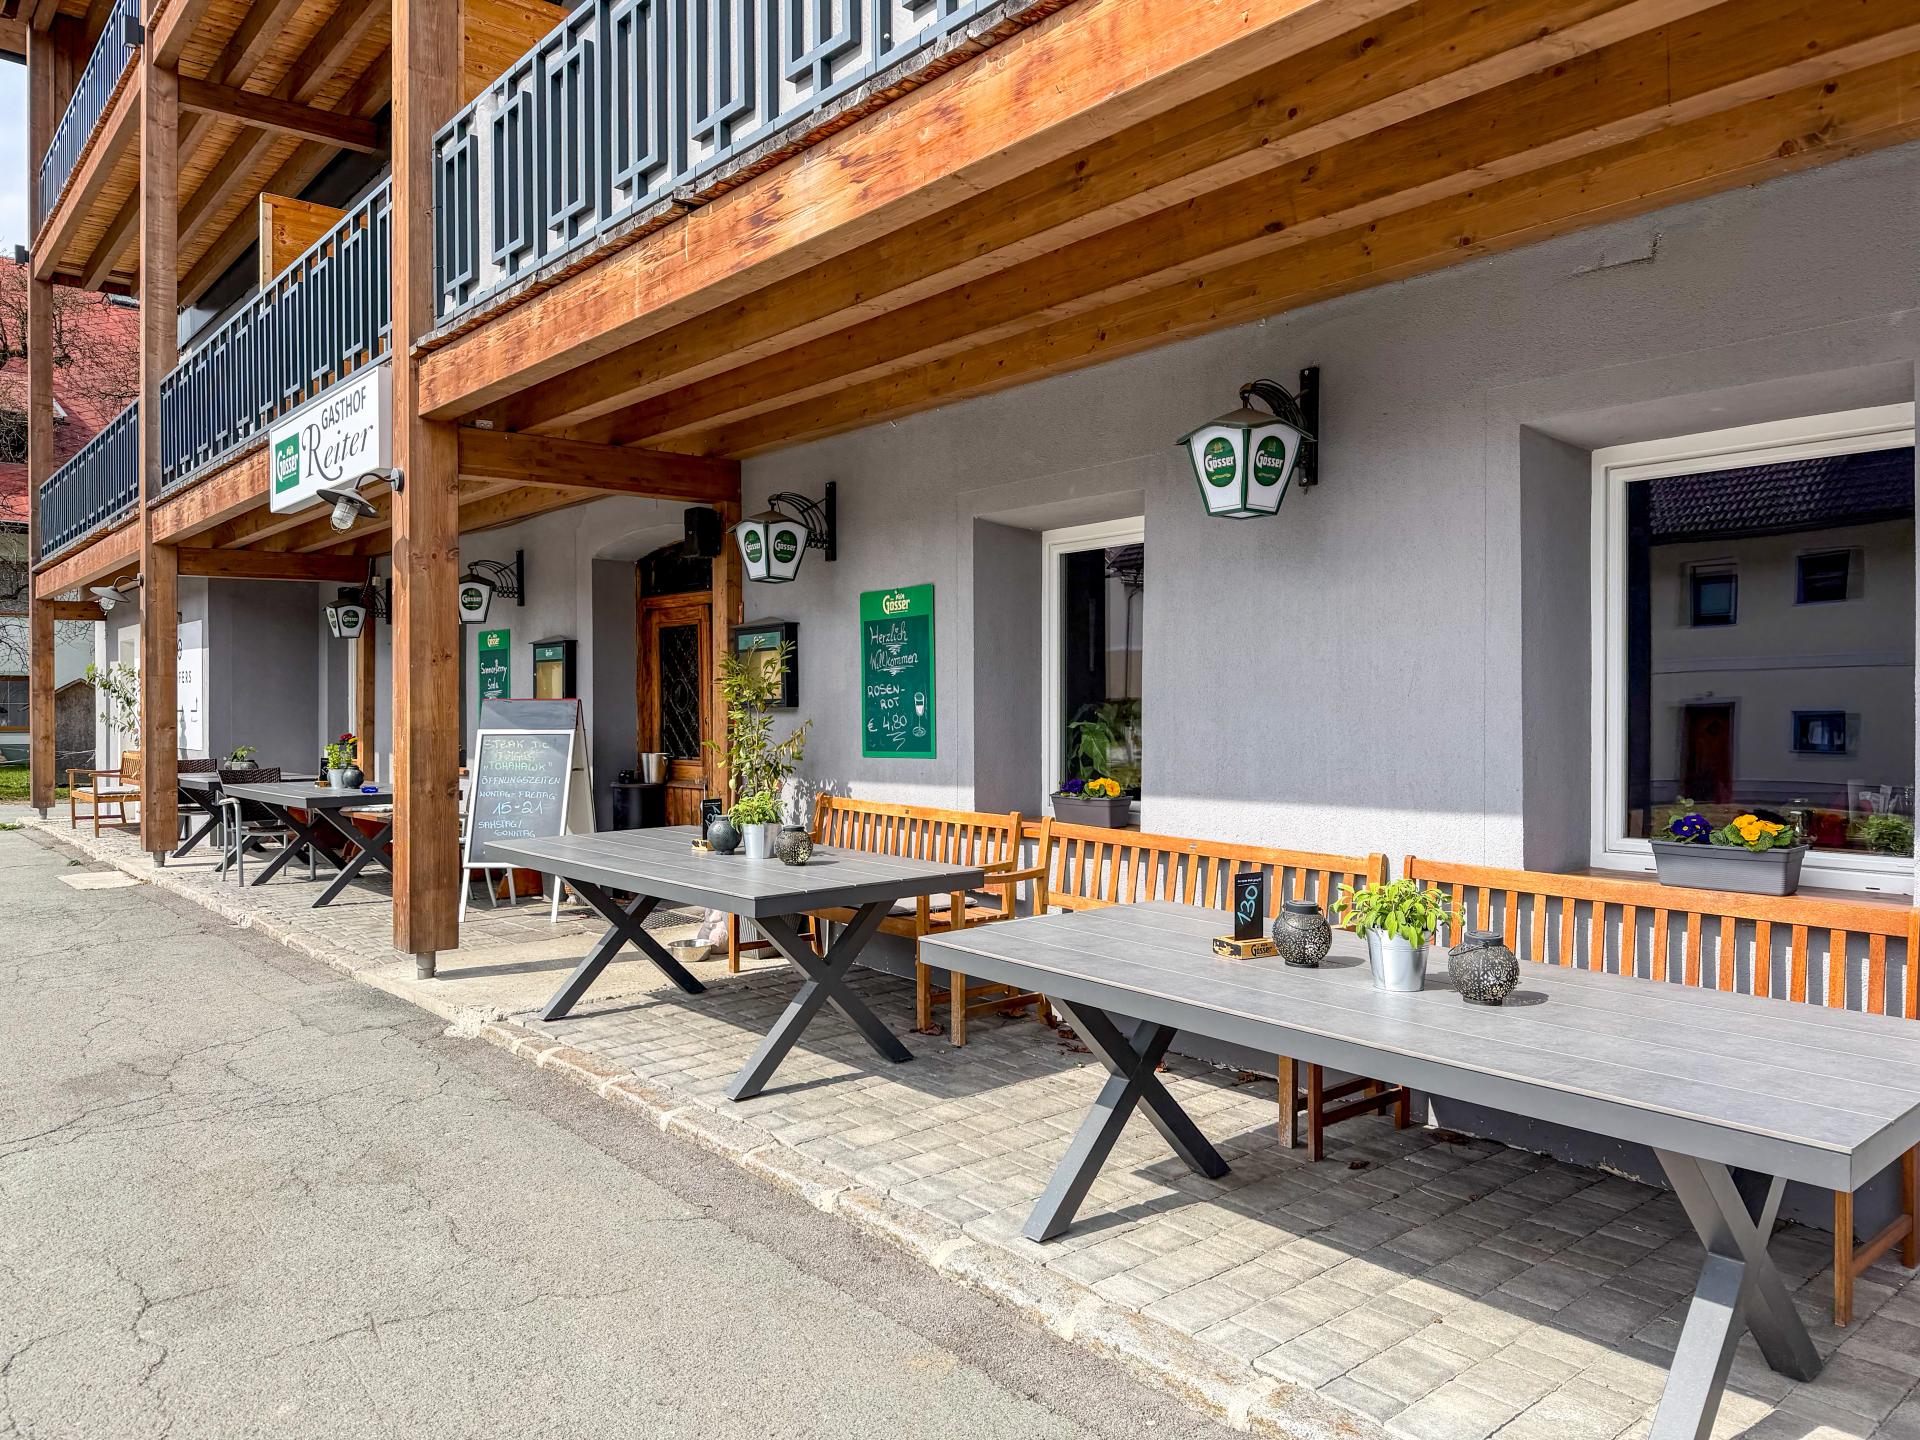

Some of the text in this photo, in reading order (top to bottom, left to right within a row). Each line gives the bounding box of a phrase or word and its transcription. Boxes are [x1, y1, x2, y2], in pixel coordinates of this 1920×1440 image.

[321, 385, 366, 430] GASTHOF
[301, 423, 373, 481] Reiter
[1255, 449, 1283, 469] Gösser
[277, 450, 298, 482] Gösser
[1204, 454, 1234, 472] Gösser
[774, 539, 796, 552] Gösser
[882, 594, 911, 615] Gösser
[869, 621, 908, 645] Herzlich
[870, 651, 919, 671] Willkommen
[868, 683, 906, 698] ROSEN-
[880, 696, 899, 710] ROT
[867, 714, 907, 732] € 4,80
[1237, 885, 1258, 925] 130
[1251, 944, 1272, 957] Gösser
